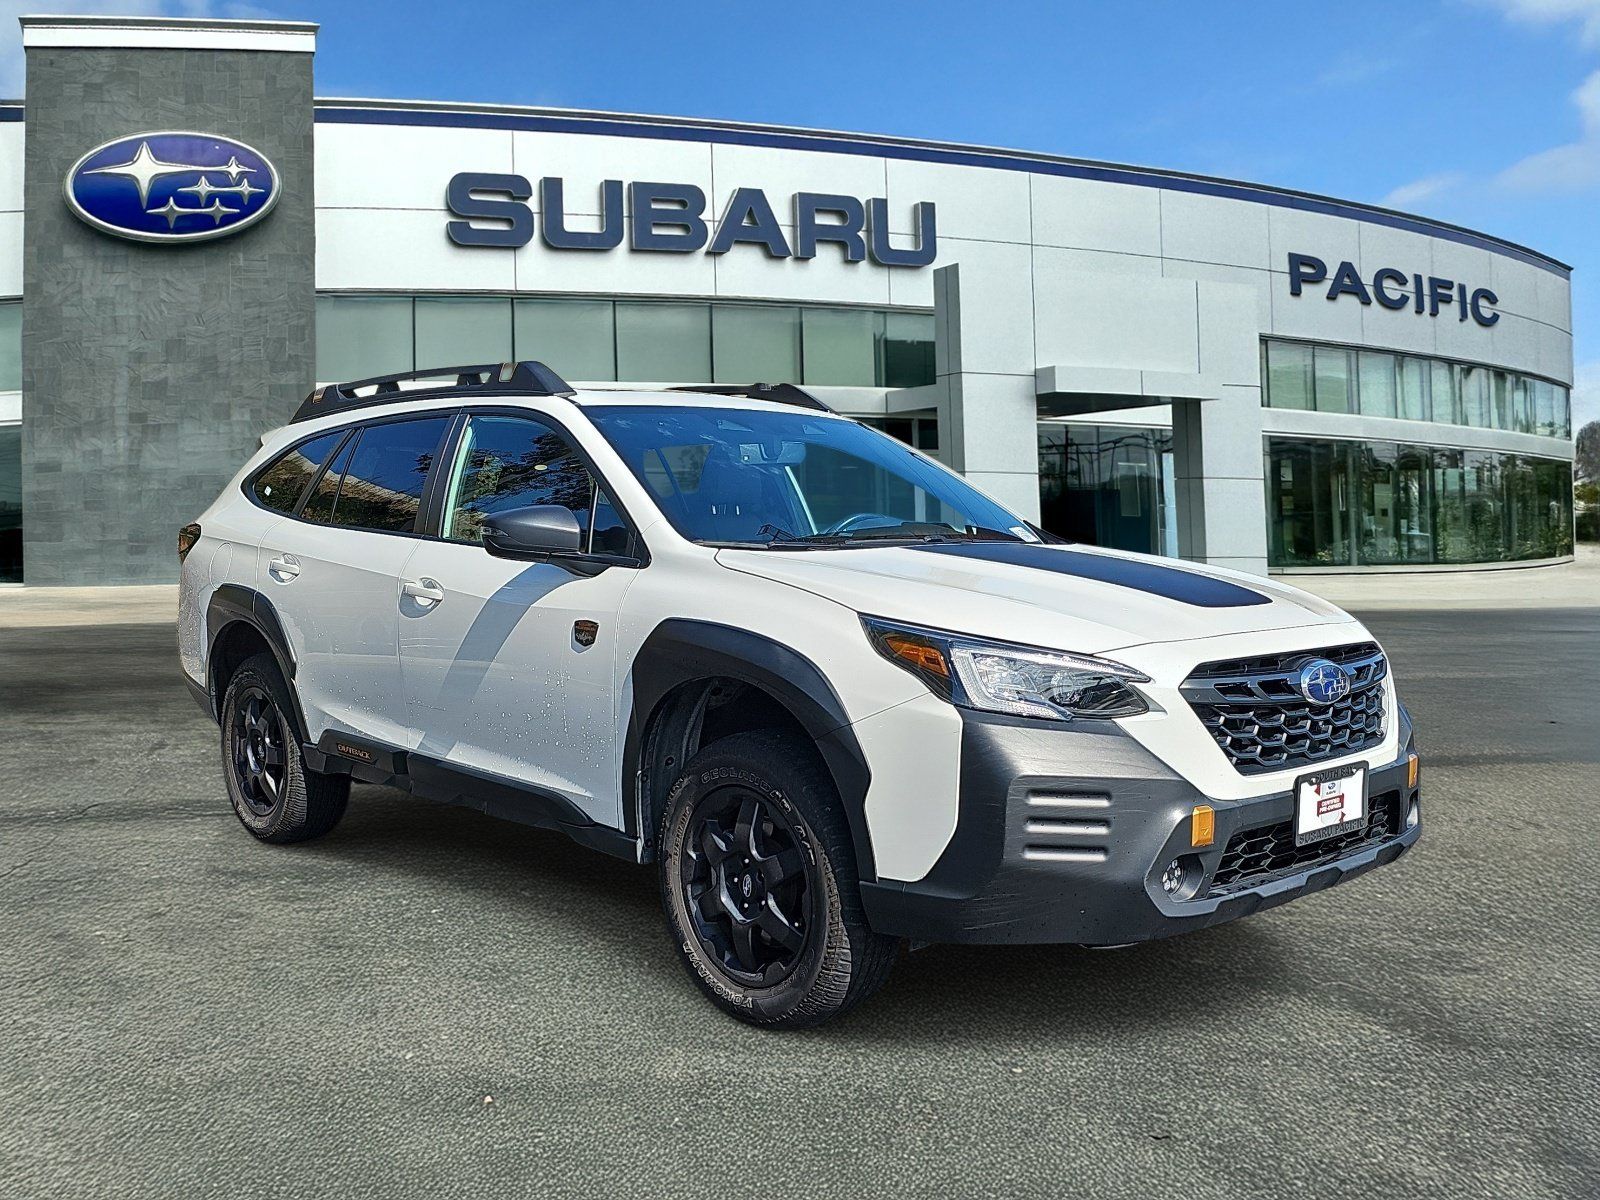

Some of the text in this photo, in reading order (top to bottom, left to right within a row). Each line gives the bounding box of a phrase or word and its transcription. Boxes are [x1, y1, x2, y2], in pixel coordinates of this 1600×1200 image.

[446, 171, 938, 268] SUBARU
[1288, 251, 1501, 328] PACIFIC
[337, 744, 371, 760] OUTBACK
[1317, 769, 1340, 781] SOUTH
[1299, 819, 1366, 844] SUBARU PACIFIC
